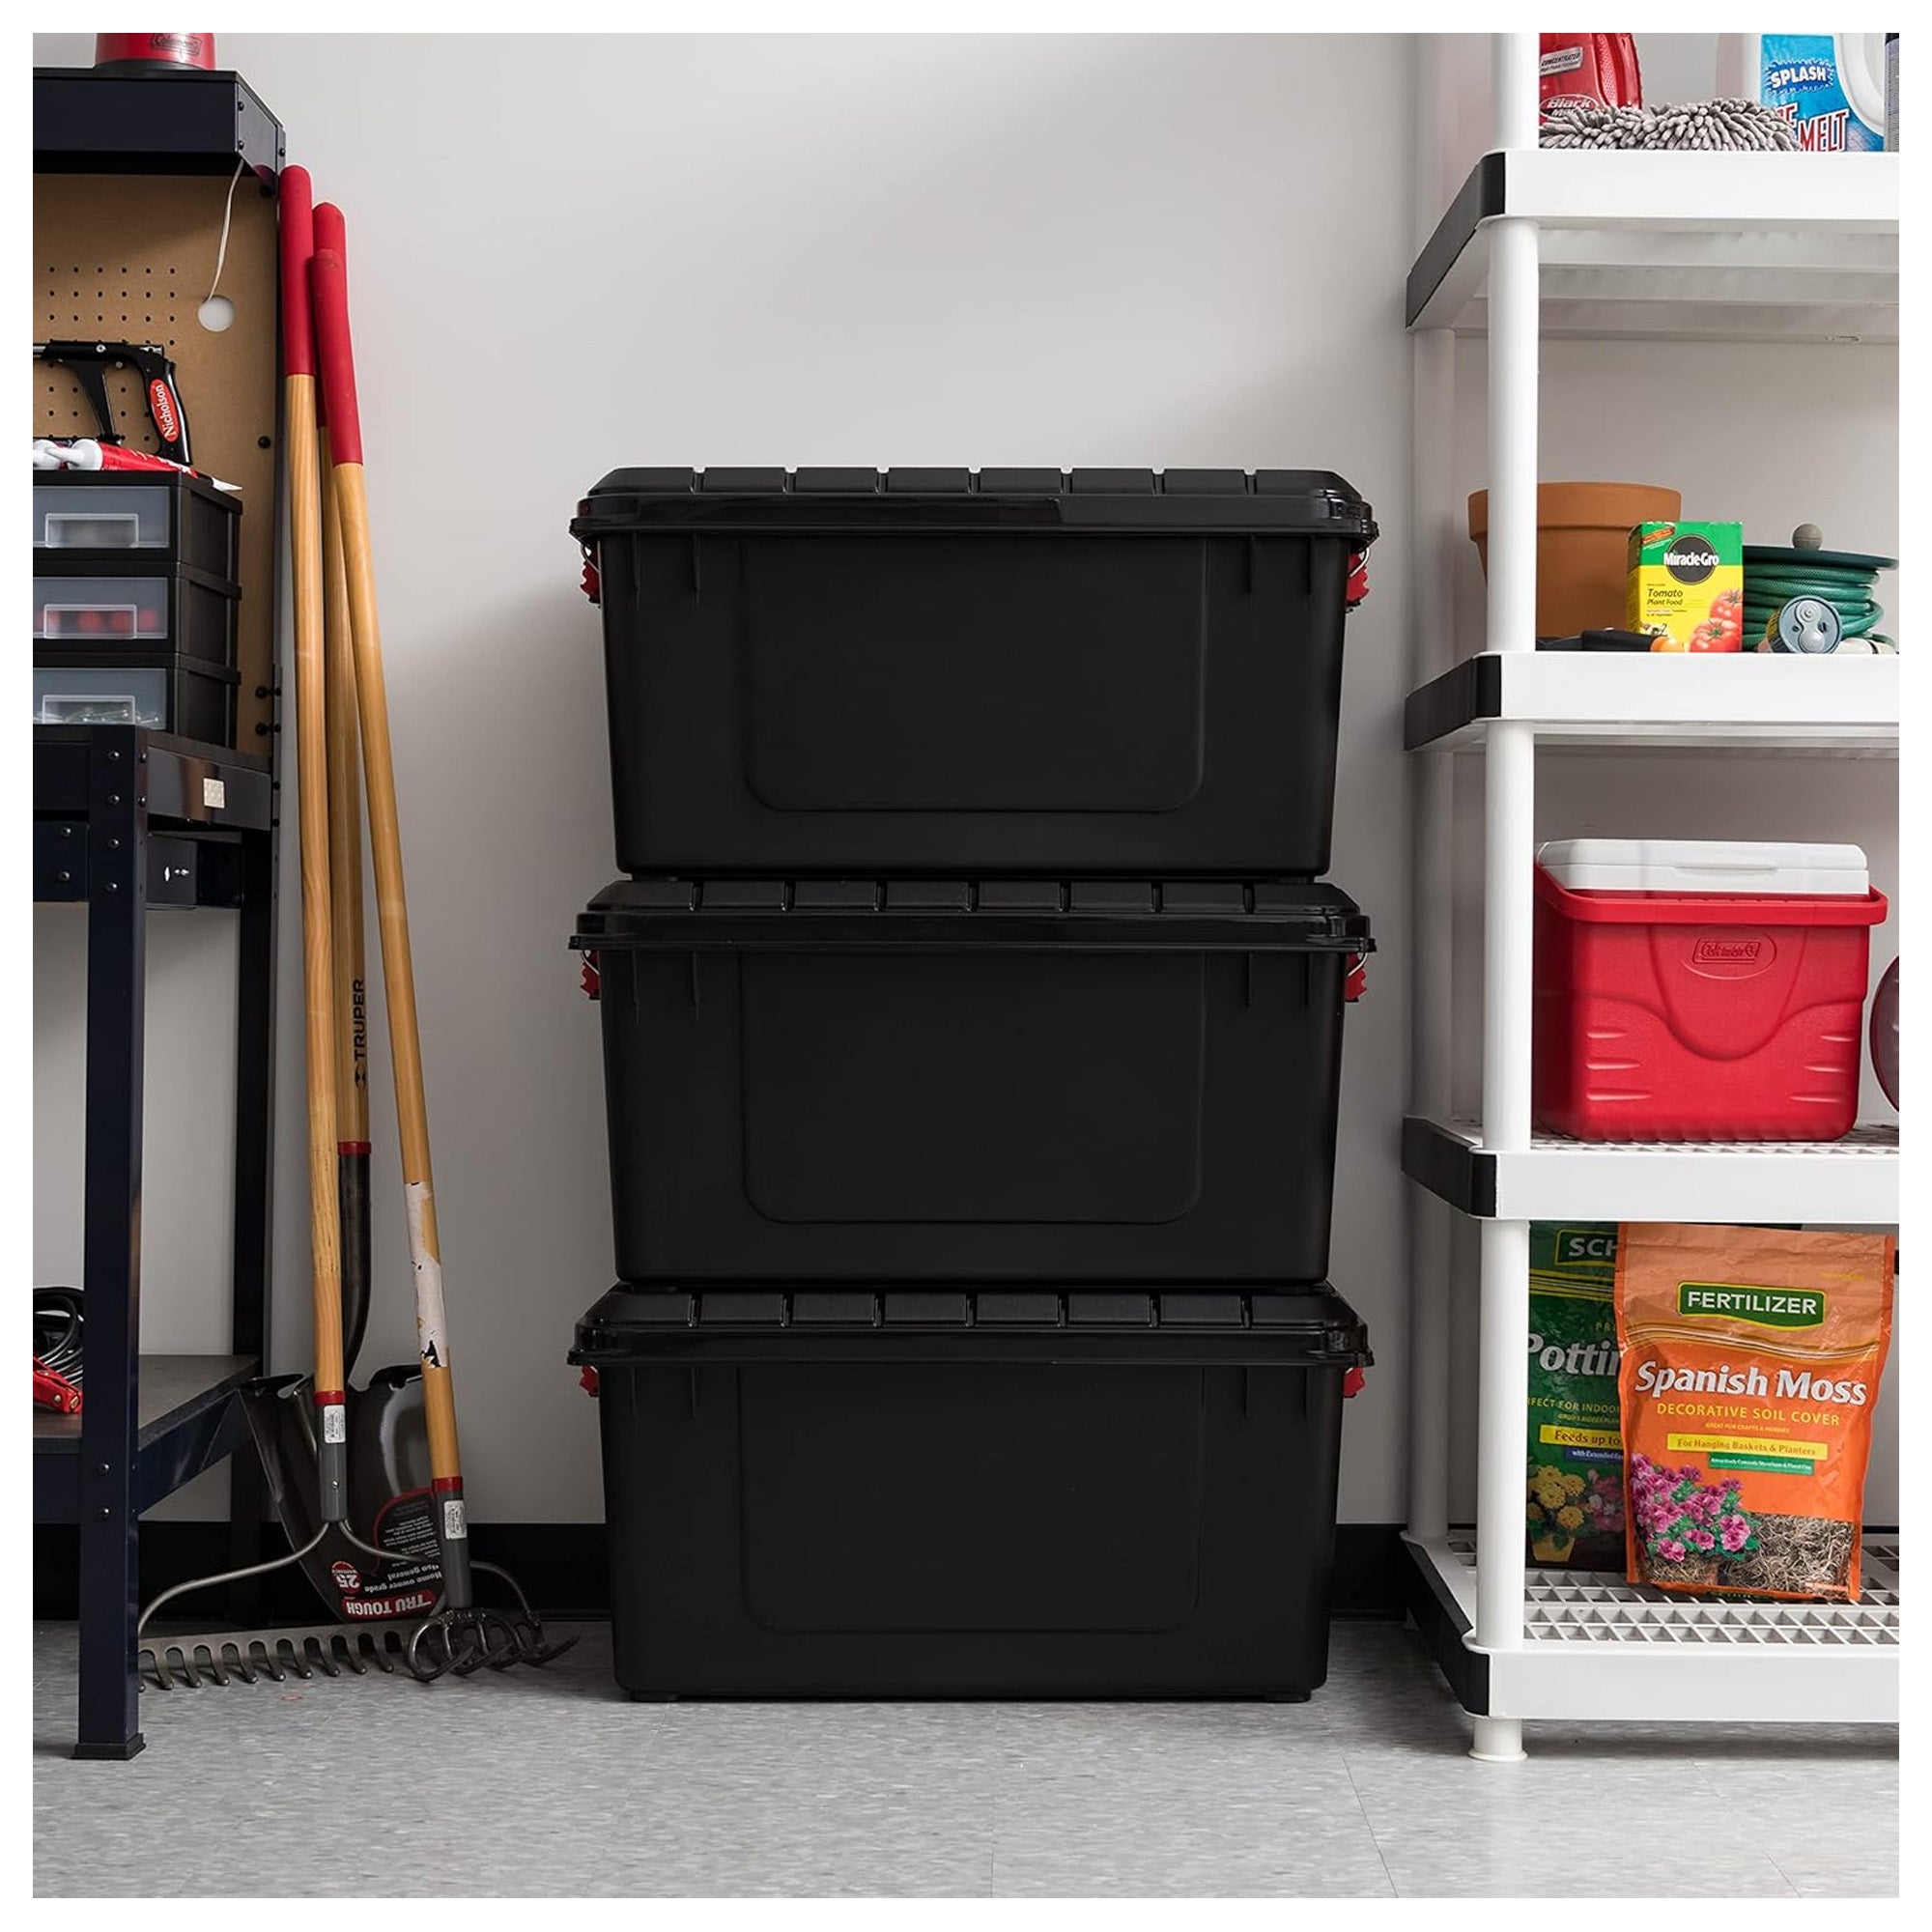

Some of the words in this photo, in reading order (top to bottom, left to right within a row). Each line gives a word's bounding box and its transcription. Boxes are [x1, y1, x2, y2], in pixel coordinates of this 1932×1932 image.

[1770, 66, 1828, 89] SPLASH
[1798, 109, 1849, 151] MELT
[155, 384, 177, 438] Nicholson
[1648, 588, 1684, 597] Tomato
[353, 979, 366, 1062] TRUPER
[1687, 1291, 1817, 1315] FERTILIZER
[1634, 1360, 1769, 1398] Spanish
[1776, 1369, 1868, 1406] Moss
[1557, 1400, 1580, 1411] FOR
[1581, 1403, 1620, 1413] INDOO
[1657, 1403, 1748, 1419] DECORATIVE
[1752, 1407, 1786, 1421] SOIL
[1791, 1410, 1841, 1426] COVER
[1555, 1430, 1588, 1443] Feeds
[1591, 1435, 1605, 1446] up
[1608, 1436, 1621, 1446] to
[1677, 1438, 1692, 1448] For
[1694, 1440, 1730, 1451] Hanging
[1733, 1441, 1767, 1452] Baskets
[1778, 1445, 1816, 1456] Planters
[335, 1574, 360, 1588] 25
[387, 1565, 419, 1581] general
[363, 1582, 387, 1594] grade
[388, 1578, 414, 1589] owner
[346, 1600, 392, 1616] TOUGH
[395, 1593, 432, 1613] TRU
